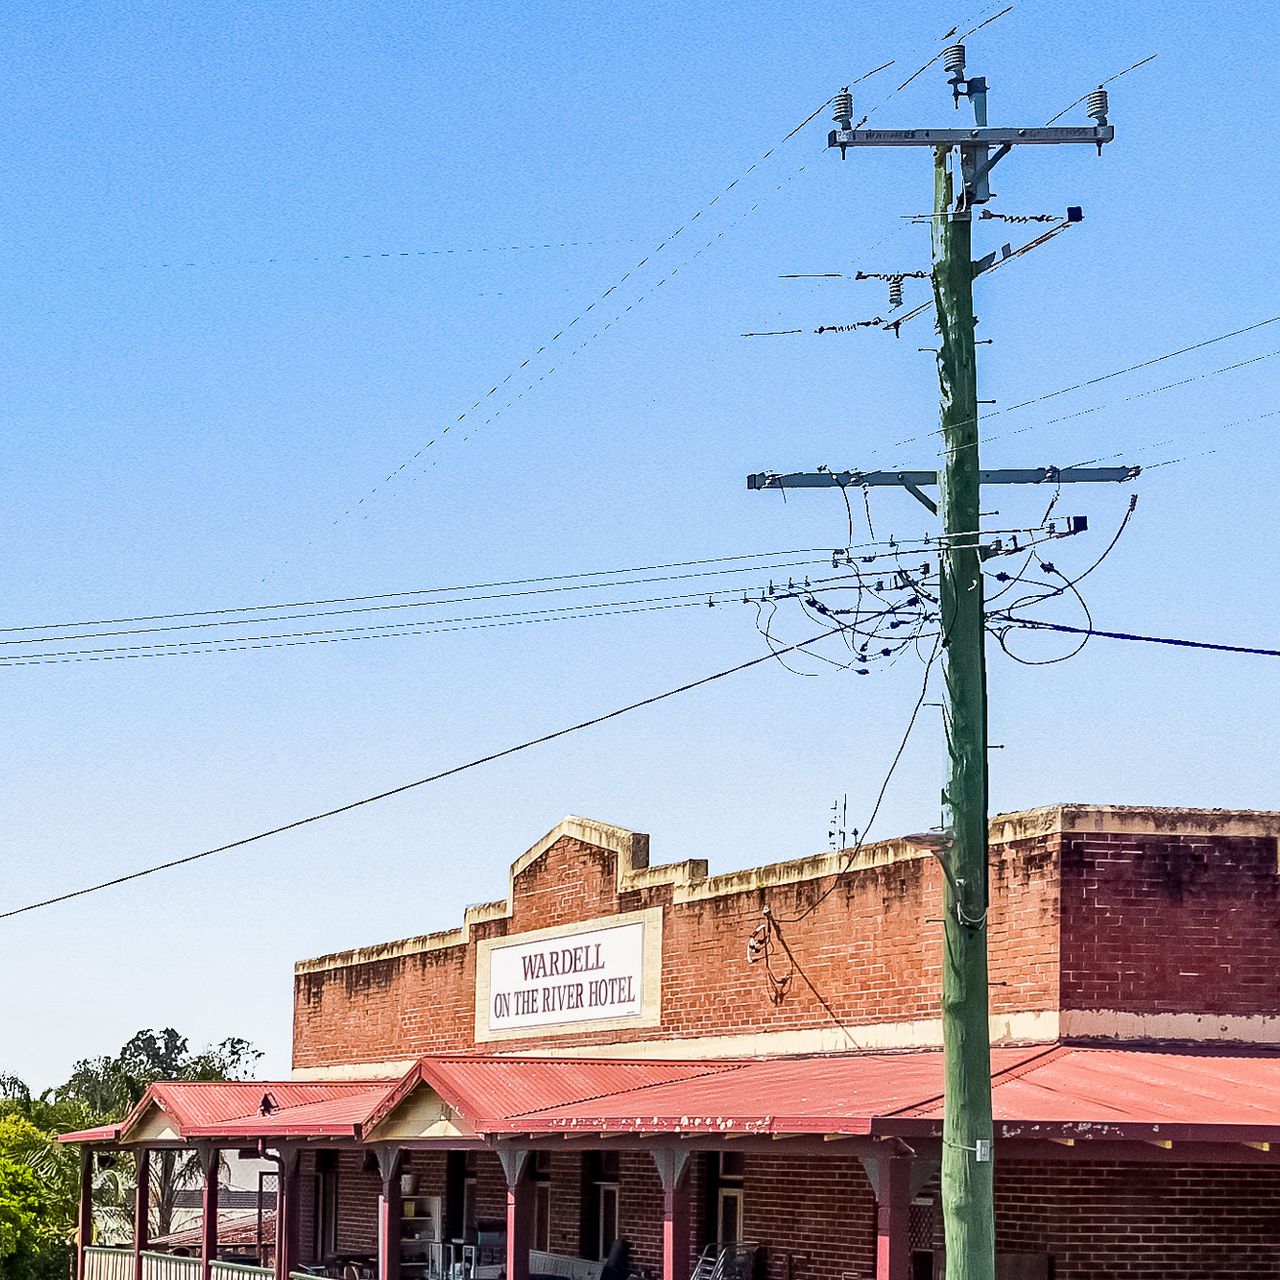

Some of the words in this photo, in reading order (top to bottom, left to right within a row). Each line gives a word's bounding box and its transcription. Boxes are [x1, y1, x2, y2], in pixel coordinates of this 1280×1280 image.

[521, 943, 606, 981] WARDELL
[494, 991, 511, 1019] ON
[514, 988, 539, 1016] THE
[542, 982, 584, 1013] RIVER
[588, 975, 636, 1007] HOTEL
